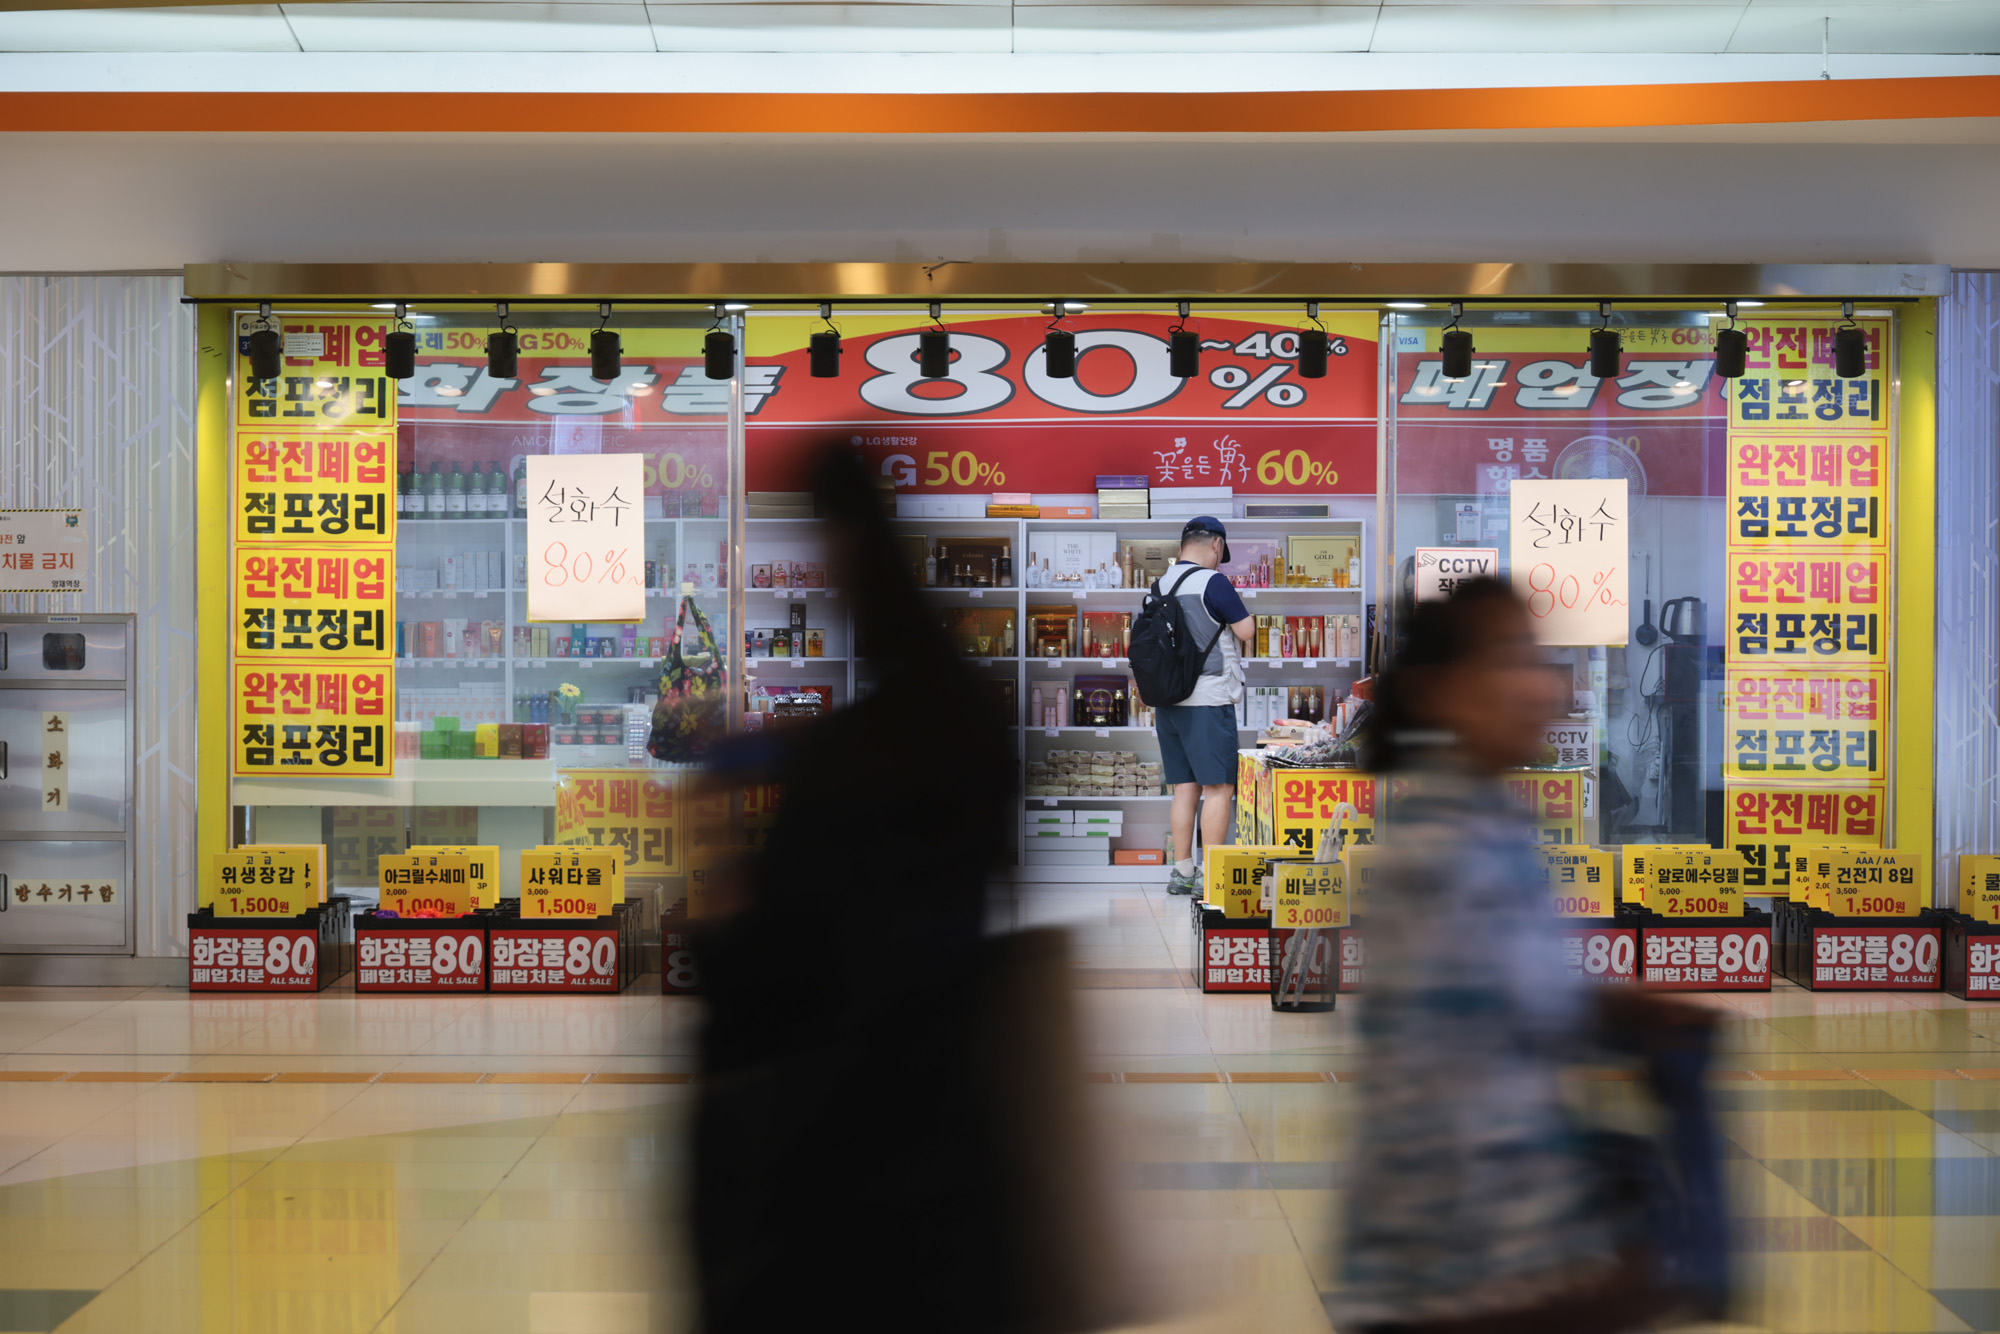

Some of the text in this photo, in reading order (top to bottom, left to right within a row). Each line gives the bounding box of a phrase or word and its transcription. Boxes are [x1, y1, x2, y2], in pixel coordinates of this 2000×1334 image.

[541, 332, 585, 350] 50%
[1399, 336, 1419, 345] VISA
[1671, 327, 1716, 346] 60%
[397, 362, 787, 415] 화장품
[1399, 359, 1727, 410] 폐업정
[245, 376, 386, 419] 점포정리
[1738, 379, 1880, 421] 점포정리
[866, 436, 918, 446] LG생활건강
[1487, 438, 1550, 462] 명품
[244, 440, 386, 484] 완전폐업
[924, 450, 1006, 487] 50%
[1257, 449, 1338, 486] 60%
[1737, 443, 1879, 487] 완전폐업
[538, 479, 632, 527] 설화수
[243, 492, 386, 535] 점포정리
[1737, 496, 1878, 538] 점포정리
[1521, 498, 1618, 549] 설화수
[16, 534, 26, 545] 앞
[42, 553, 74, 570] 금지
[1438, 558, 1489, 574] CCTV
[243, 556, 385, 600] 완전폐업
[1736, 561, 1878, 604] 완전폐업
[243, 608, 384, 651] 점포정리
[1736, 612, 1877, 655] 점포정리
[243, 672, 384, 715] 완전폐업
[1735, 678, 1877, 720] 완전폐업
[242, 724, 384, 767] 점포정리
[1546, 731, 1588, 744] CCTV
[1557, 748, 1589, 762] 동중
[1735, 729, 1877, 772] 점포정리
[46, 715, 64, 806] 소화기
[1283, 779, 1376, 819] 완전폐
[1735, 792, 1876, 835] 완전폐업
[246, 856, 272, 865] 고급
[411, 857, 438, 866] 고급
[553, 857, 579, 866] 고급
[1685, 856, 1711, 865] 고급
[1855, 857, 1874, 865] AAA
[1883, 857, 1896, 865] AA
[221, 866, 295, 884] 위생장갑
[384, 868, 465, 884] 아크릴수세미
[528, 868, 602, 886] 샤워타올
[1233, 868, 1266, 885] 미용
[1306, 868, 1329, 876] 고급
[1658, 868, 1739, 884] 알로에수딩젤
[1836, 867, 1914, 884] 건전지 8입
[220, 887, 242, 895] 3,000
[386, 888, 407, 896] 2,000
[1286, 877, 1342, 896] 비닐우산
[1659, 887, 1737, 895] 5,000 99%
[1836, 887, 1858, 895] 3,500
[230, 897, 290, 915] 1,500원
[396, 898, 455, 916] 1,000원
[537, 898, 597, 916] 1,500원
[1668, 897, 1729, 915] 2,500원
[1846, 897, 1906, 915] 1,500원
[1287, 908, 1341, 926] 3,000원
[192, 936, 266, 967] 화장품
[360, 936, 432, 967] 화장품
[492, 936, 566, 968] 화장품
[1645, 935, 1719, 966] 화장품
[1816, 934, 1889, 965] 화장품
[192, 968, 265, 984] 폐업처분
[270, 977, 312, 985] ALL SALE
[359, 969, 433, 984] 폐업처분
[437, 977, 479, 985] ALL SALE
[492, 969, 566, 985] 폐업처분
[570, 977, 612, 986] ALL SALE
[1608, 976, 1631, 984] SALE
[1645, 966, 1719, 982] 폐업처분
[1723, 975, 1765, 983] ALL SALE
[1815, 966, 1889, 982] 폐업처분
[1893, 975, 1935, 983] ALL SALE
